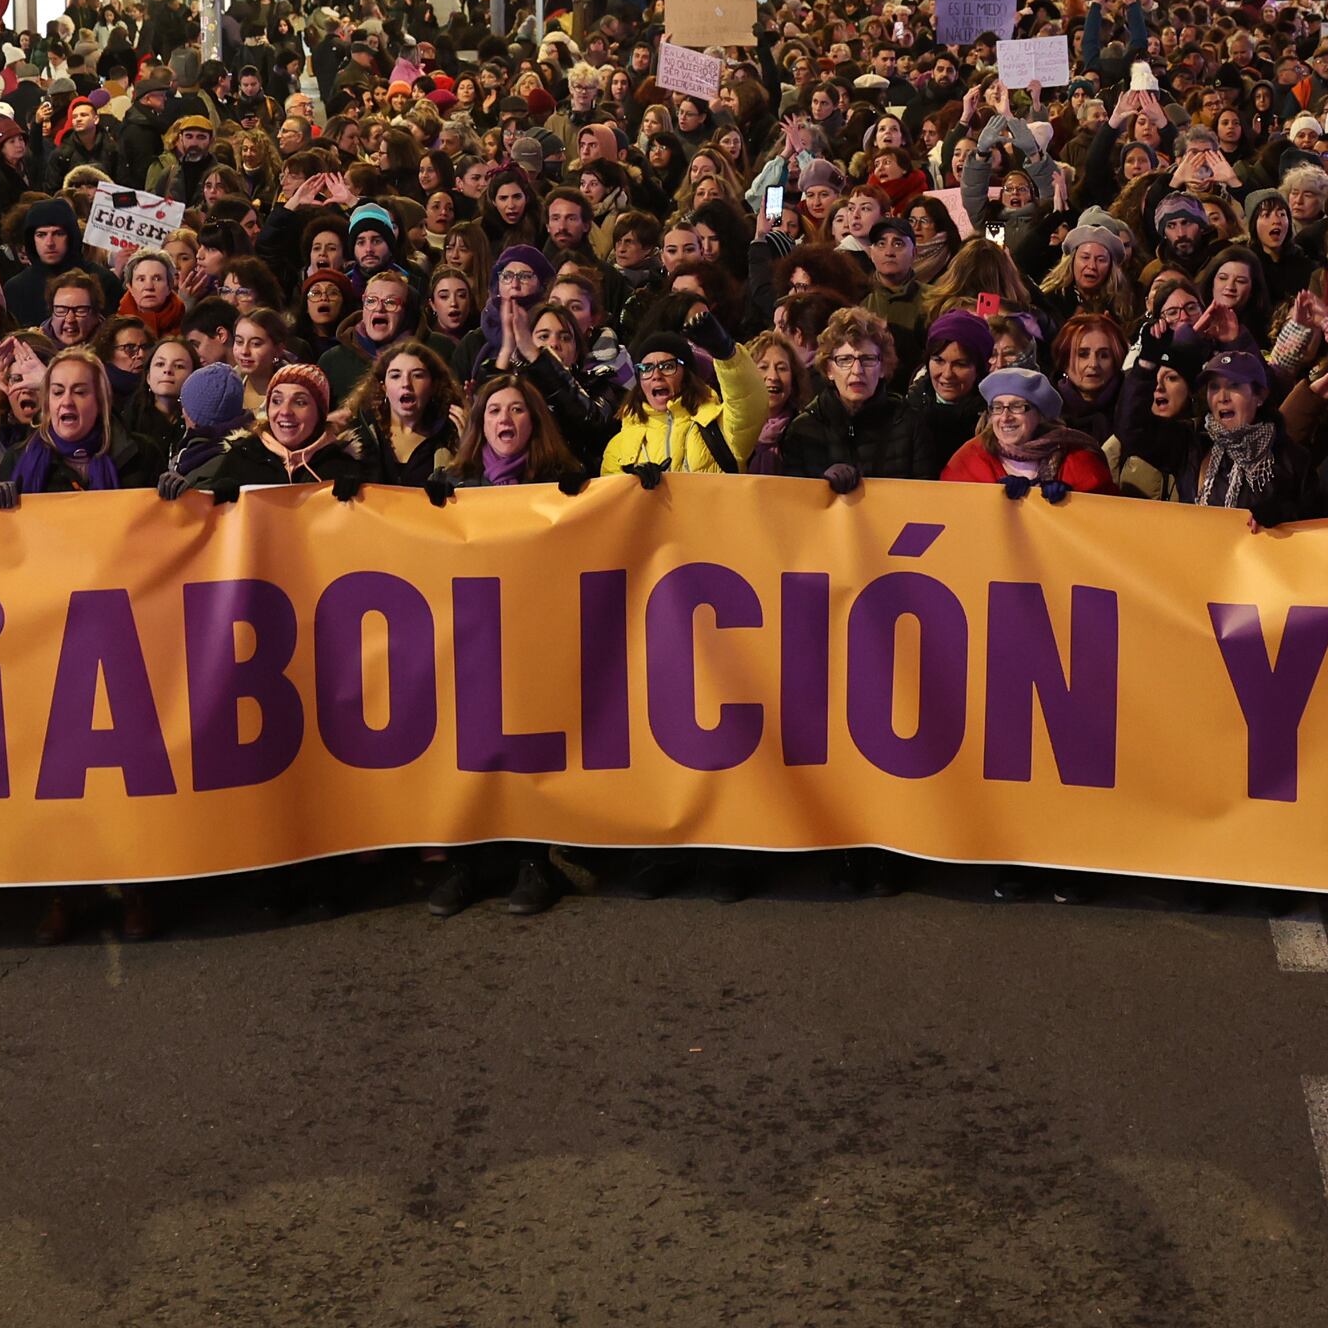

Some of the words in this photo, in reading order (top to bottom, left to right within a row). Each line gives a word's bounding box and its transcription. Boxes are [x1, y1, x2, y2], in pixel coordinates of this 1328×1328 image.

[948, 2, 960, 16] ES
[963, 2, 974, 16] EL
[94, 209, 135, 231] riot
